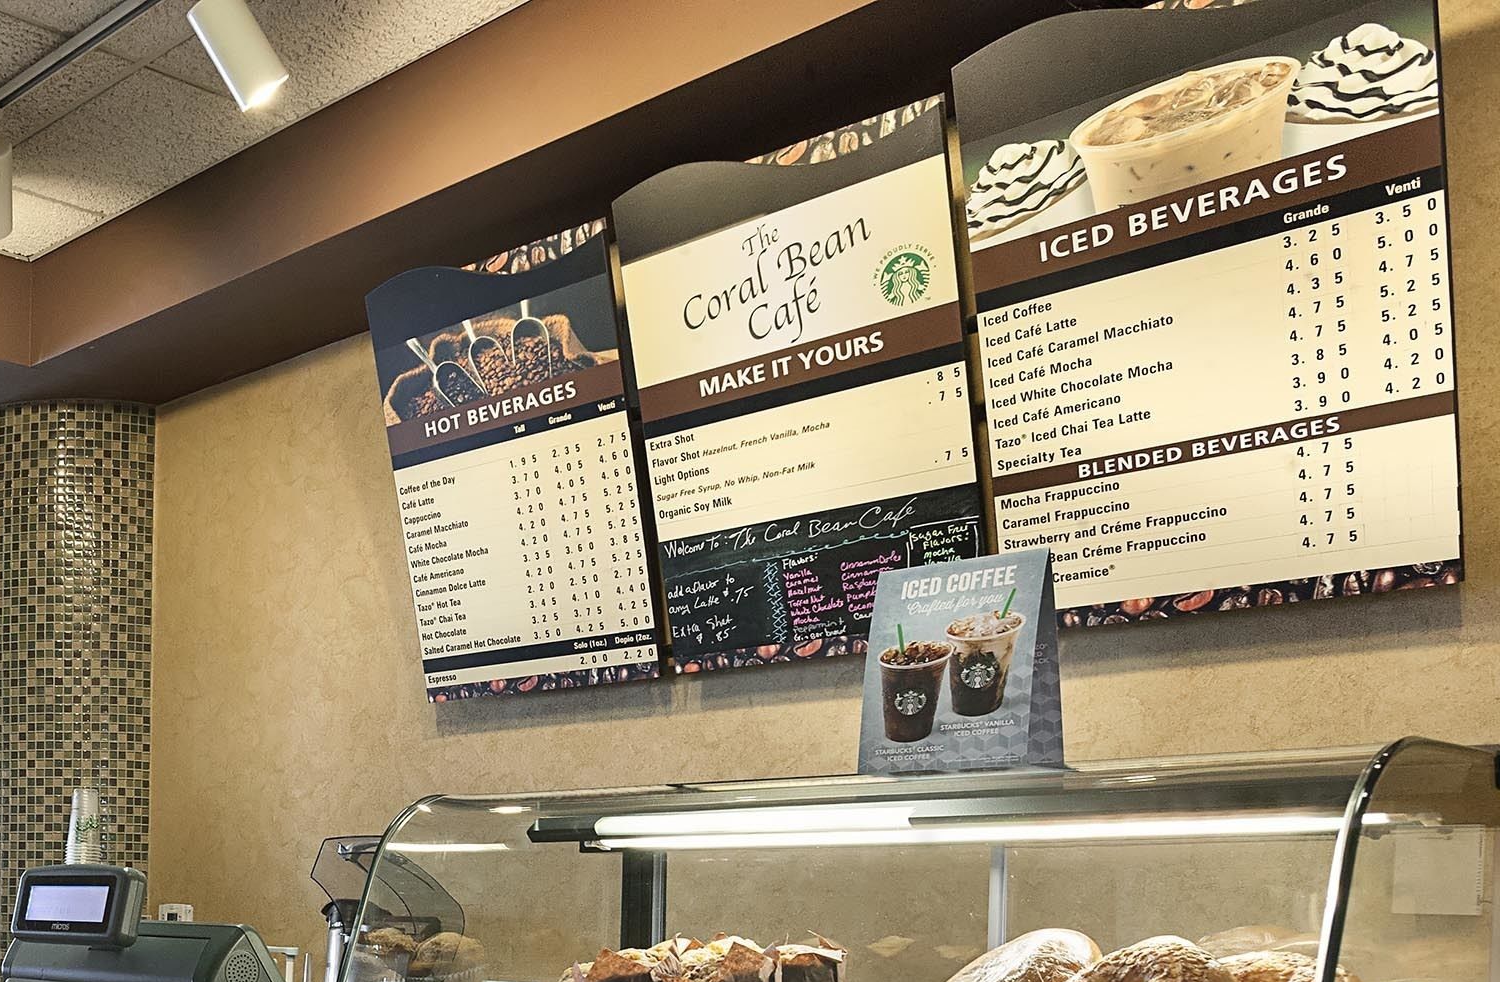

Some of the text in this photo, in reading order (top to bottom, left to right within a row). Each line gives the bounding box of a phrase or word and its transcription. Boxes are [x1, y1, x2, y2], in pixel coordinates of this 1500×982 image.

[1039, 154, 1346, 262] ICED BEVERAGES
[1283, 176, 1421, 224] Grande Venti
[741, 223, 779, 257] The
[880, 243, 912, 265] PROUDLY
[915, 244, 935, 261] SERVE
[683, 216, 872, 330] Coral Bean
[748, 273, 821, 344] Café
[983, 302, 1052, 327] Iced Coffee
[985, 318, 1077, 348] Iced Café Latte
[987, 316, 1173, 368] Iced Café Caramel Macchiato
[699, 331, 884, 397] MAKE IT YOURS
[989, 357, 1092, 389] Iced Café Mocha
[991, 361, 1173, 409] Iced White Chocolate Mocha
[424, 380, 576, 437] HOT BEVERAGES
[513, 399, 616, 434] Tall Grande Venti
[993, 395, 1121, 429] Iced Café Americano
[1031, 427, 1057, 442] Iced
[1061, 420, 1088, 436] Chai
[1091, 418, 1114, 430] Tea
[1118, 410, 1151, 425] Latte
[649, 433, 694, 451] Extra Shot
[651, 421, 830, 468] Flavor Shot Hazelnut, French Vanilla, Mocha
[1078, 416, 1340, 478] BLENDED BEVERAGES
[997, 446, 1081, 471] Specialty Tea
[399, 476, 455, 495] Coffee of the Day
[654, 466, 710, 486] Light Options
[656, 461, 815, 502] Sugar Free Syrup, No Whip, Non-Fat Milk
[401, 497, 434, 510] Café Latte
[658, 496, 732, 519] Organic Soy Milk
[1000, 481, 1120, 510] Mocha Frappuccino
[403, 511, 441, 525] Cappuccino
[406, 520, 469, 540] Caramel Macchiato
[1002, 501, 1130, 530] Caramel Frappuccino
[1004, 506, 1227, 550] Strawberry and Créme Frappuccino
[408, 540, 447, 554] Café Mocha
[664, 539, 704, 559] Welcome
[727, 526, 756, 549] The
[763, 521, 801, 543] Coral
[808, 515, 853, 538] Bean
[1082, 544, 1122, 558] Créme
[1126, 531, 1206, 552] Frappuccino
[410, 546, 489, 568] White Chocolate Mocha
[413, 568, 464, 583] Café Americano
[415, 579, 486, 597] Cinnamon Dolce Latte
[901, 565, 1018, 600] ICED COFFEE
[421, 628, 466, 641] Hot Chocolate
[423, 635, 521, 655] Salted Caramel Hot Chocolate
[573, 638, 607, 650] Solo (1oz.)
[672, 623, 700, 638] Extra
[427, 674, 457, 684] Espresso
